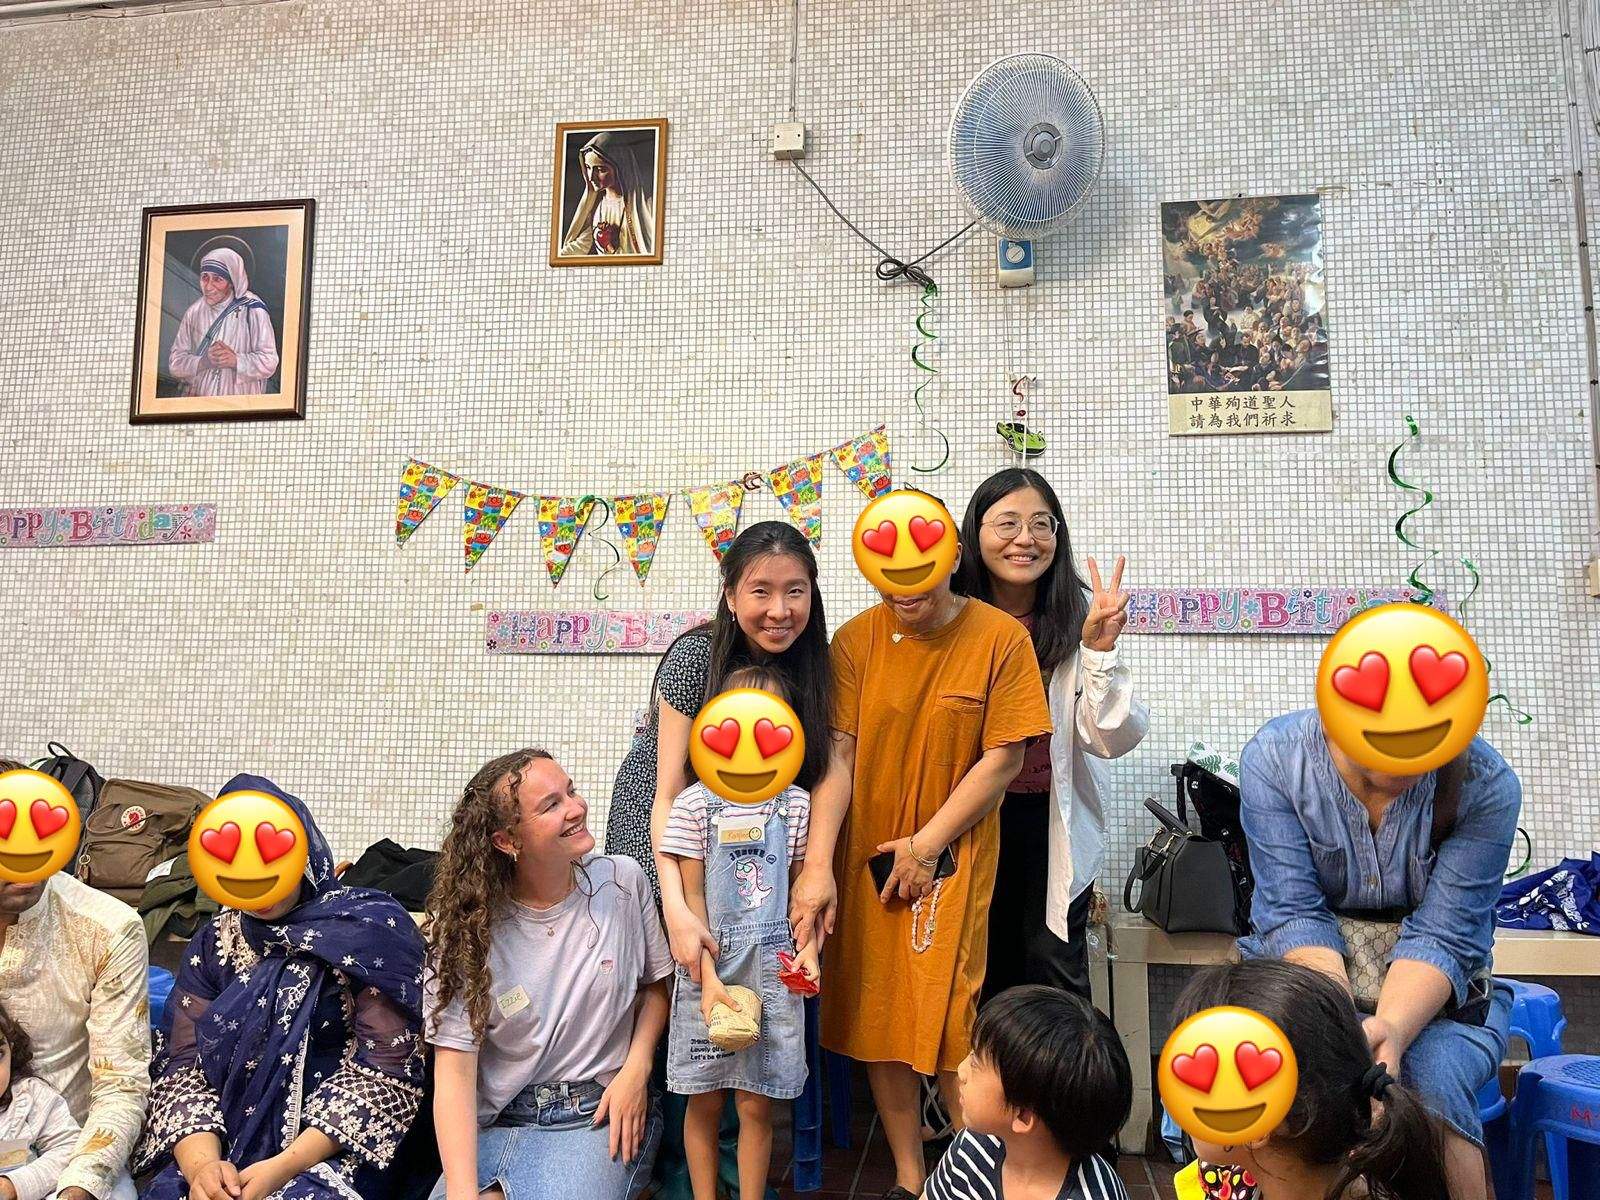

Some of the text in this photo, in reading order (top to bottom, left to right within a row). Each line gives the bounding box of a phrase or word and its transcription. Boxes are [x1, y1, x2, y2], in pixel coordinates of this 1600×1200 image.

[1189, 411, 1297, 429] 請為我們祈求
[1190, 395, 1296, 412] 中華殉道聖人
[0, 506, 192, 544] appy Birthday
[1128, 587, 1408, 630] Happy Birth
[508, 611, 609, 650] Happy
